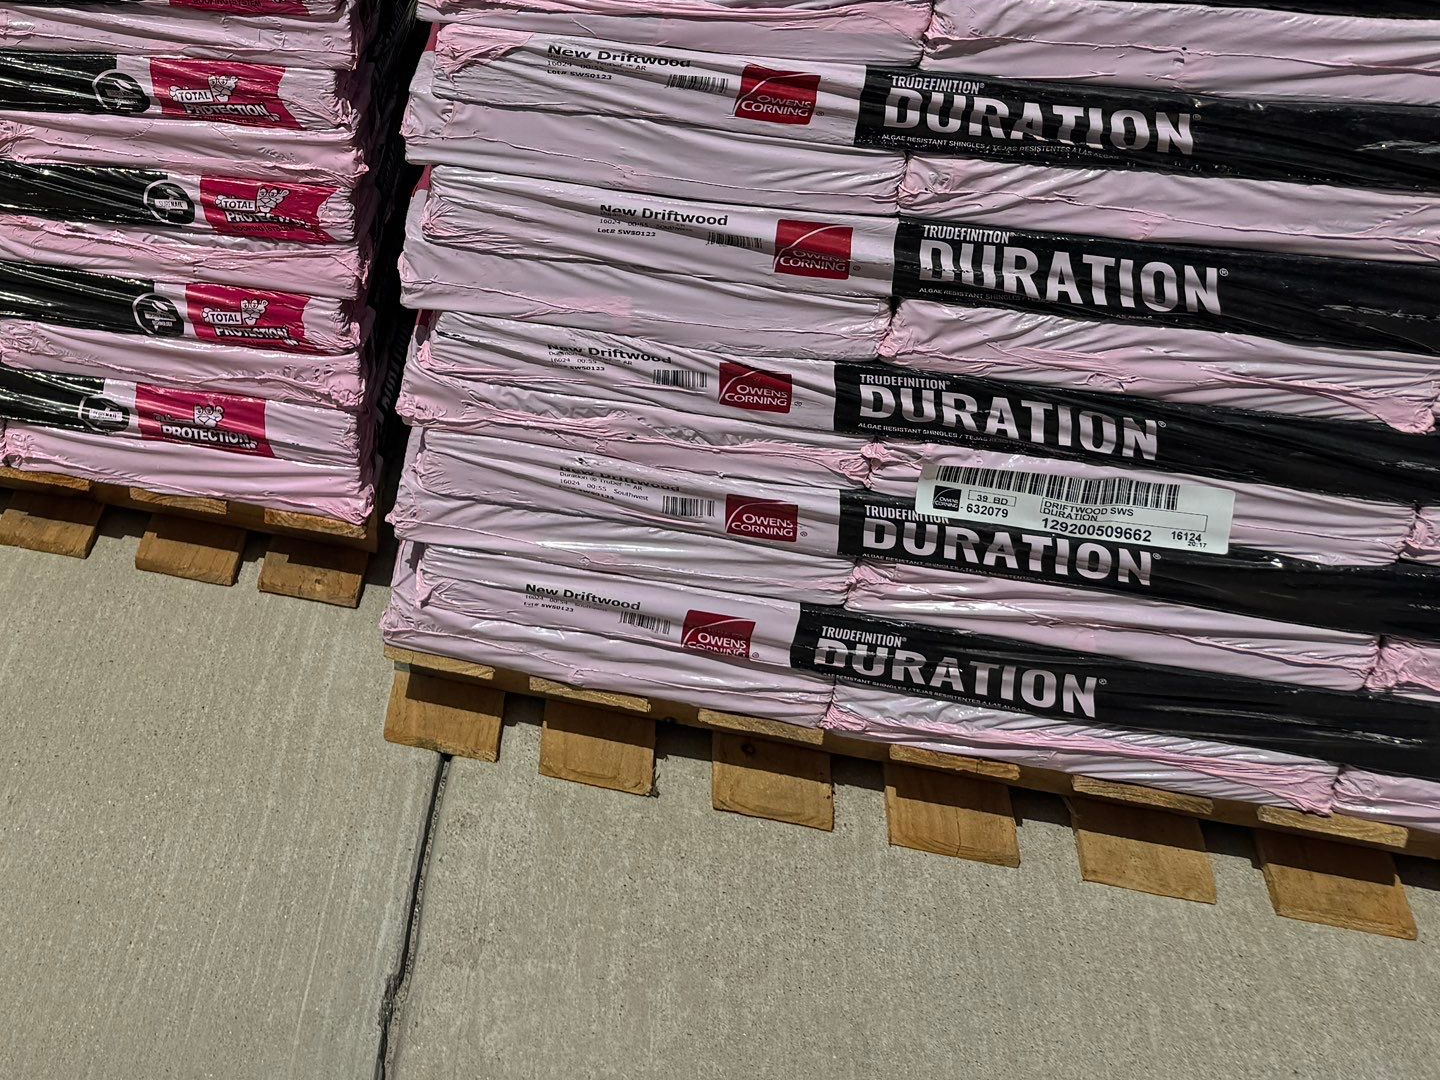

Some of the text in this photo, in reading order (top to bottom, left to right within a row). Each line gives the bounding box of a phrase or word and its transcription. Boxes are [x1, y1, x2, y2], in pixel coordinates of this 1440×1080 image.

[547, 45, 691, 68] New Driftwood
[892, 75, 980, 94] TRUDEFINITION
[741, 100, 809, 117] CORNING
[884, 88, 1194, 155] DURATION
[600, 204, 729, 226] New Driftwood
[923, 225, 1009, 244] TRUDEFINITION
[919, 239, 1221, 315] DURATION
[736, 384, 787, 398] OWENS
[860, 374, 946, 390] TRUDEFINITION
[724, 393, 787, 407] CORNING
[859, 384, 1159, 461] DURATION
[966, 503, 1009, 520] 632079
[1042, 508, 1098, 522] DURATION
[1044, 500, 1134, 516] DRIFTWOOD SWS
[1041, 517, 1152, 543] 129200509662
[1170, 530, 1202, 543] 16124
[863, 519, 1152, 586] DURATION
[525, 583, 641, 611] New Driftwood
[697, 632, 747, 649] OWENS
[821, 626, 903, 647] TRUDEFINITION
[814, 637, 1097, 718] DURATION
